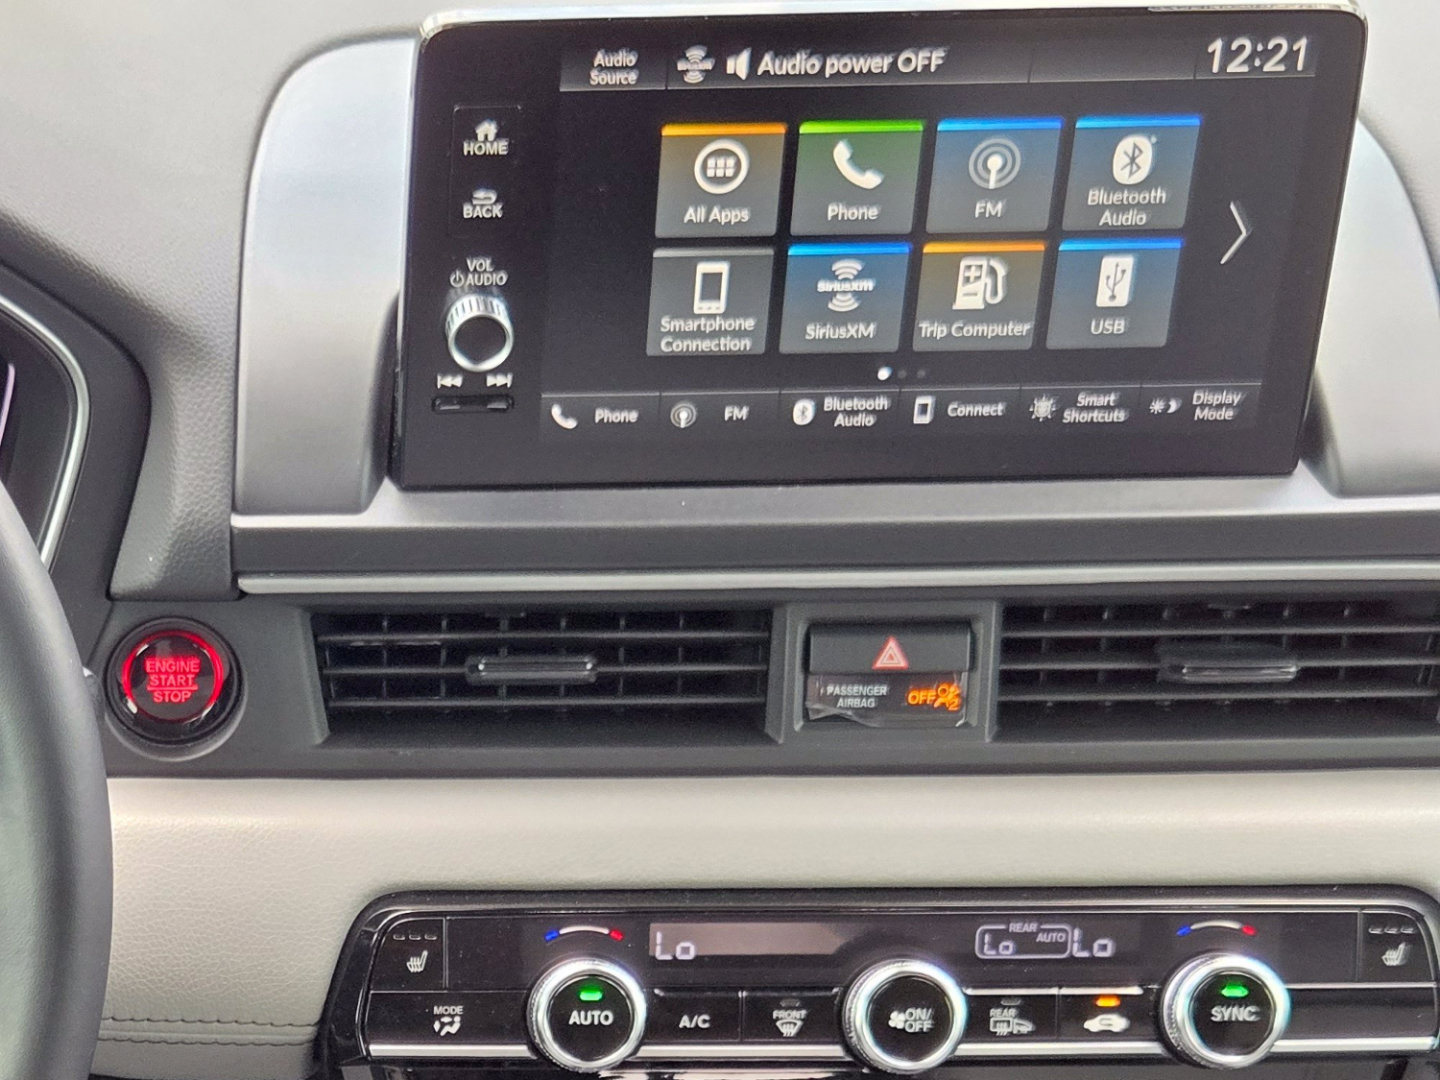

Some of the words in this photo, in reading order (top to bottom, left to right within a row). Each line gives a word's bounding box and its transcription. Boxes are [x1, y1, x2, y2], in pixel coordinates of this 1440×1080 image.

[593, 48, 638, 68] Audio
[1206, 36, 1308, 73] 12:21
[757, 49, 821, 75] Audio
[825, 52, 893, 79] power
[897, 47, 947, 73] OFF
[589, 67, 639, 85] Source
[463, 141, 509, 155] HOME
[1088, 188, 1166, 205] Bluetooth
[462, 204, 503, 219] BACK
[683, 206, 707, 224] All
[708, 207, 750, 225] Apps
[827, 203, 879, 222] Phone
[974, 201, 1003, 218] FM
[1098, 209, 1147, 227] Audio
[467, 258, 493, 272] VOL
[465, 272, 508, 286] AUDIO
[660, 316, 754, 333] Smartphone
[805, 322, 876, 340] SiriusXM
[919, 322, 948, 339] Trip
[951, 321, 1031, 339] Computer
[1090, 318, 1126, 335] USB
[660, 335, 752, 352] Connection
[823, 396, 890, 412] Bluetooth
[1076, 391, 1116, 407] Smart
[1191, 390, 1244, 409] Display
[594, 407, 639, 424] Phone
[724, 405, 749, 421] FM
[947, 402, 1006, 417] Connect
[1061, 407, 1127, 424] Shortcuts
[1193, 406, 1235, 421] Mode
[833, 411, 877, 428] Audio
[145, 658, 201, 673] ENGINE
[149, 674, 196, 687] START
[153, 690, 192, 703] STOP
[826, 684, 888, 696] PASSENGER
[907, 689, 936, 705] OFF
[835, 697, 876, 709] AIRBAG
[1008, 922, 1038, 933] REAR
[1036, 932, 1066, 943] AUTO
[433, 1005, 464, 1015] MODE
[772, 1009, 808, 1020] FRONT
[904, 1007, 934, 1021] ON/
[989, 1008, 1016, 1018] REAR
[1209, 1004, 1260, 1023] SYNC
[568, 1010, 614, 1027] AUTO
[678, 1014, 711, 1029] A/C
[904, 1020, 934, 1033] OFF
